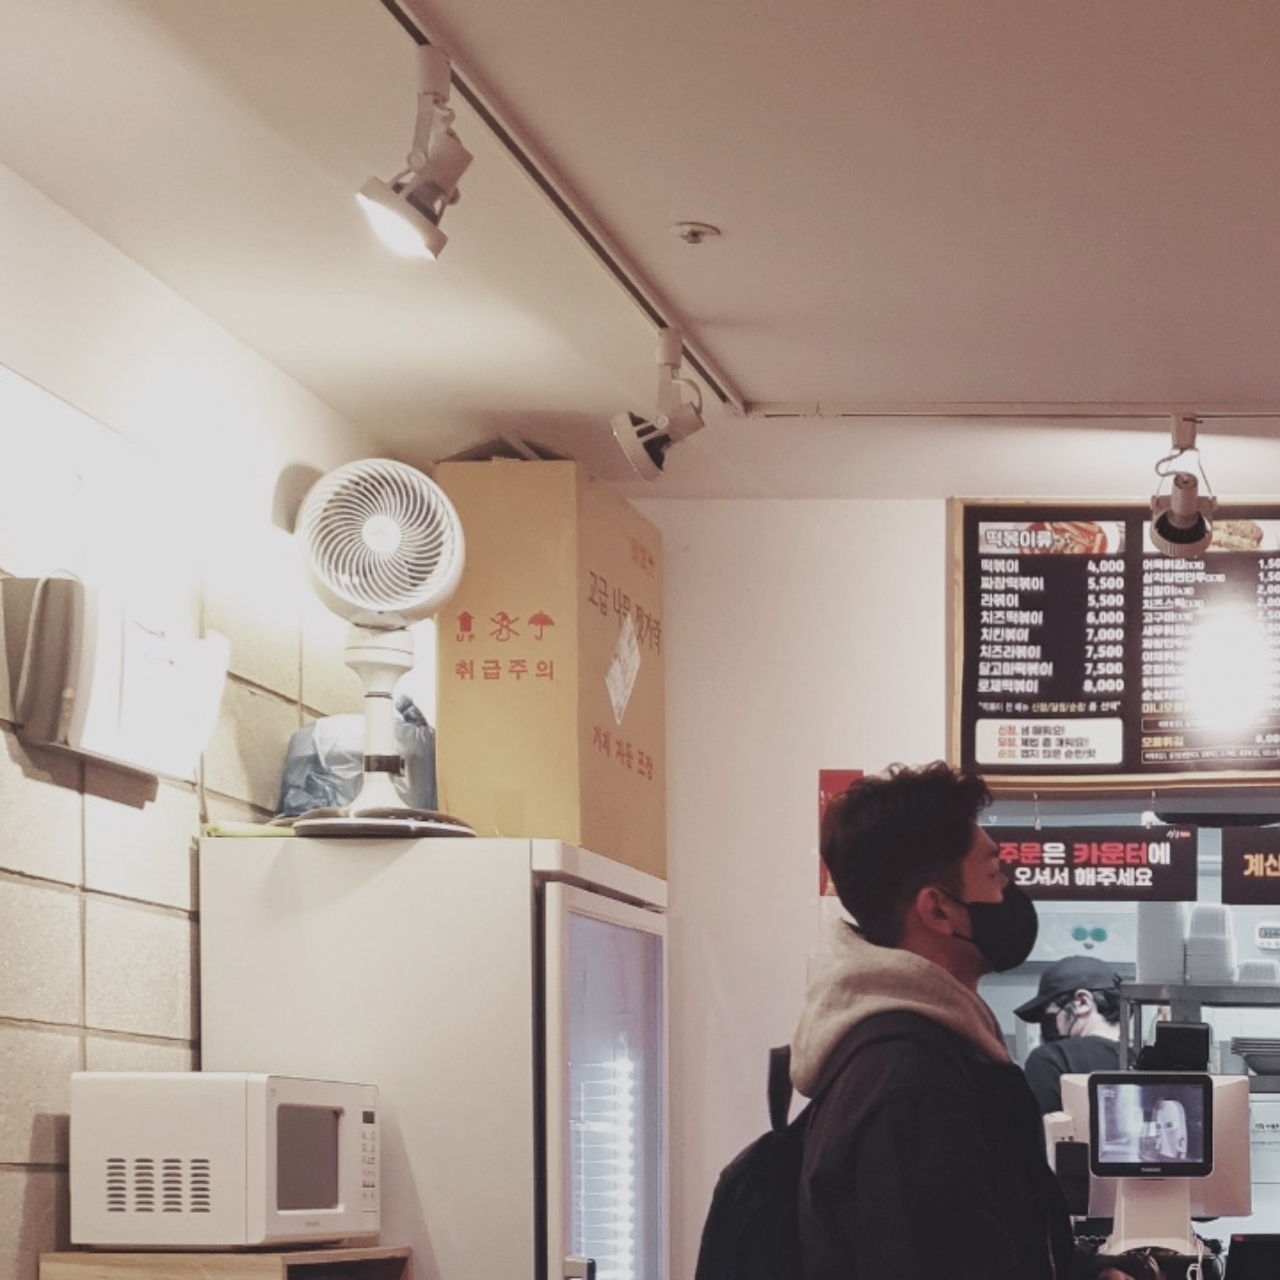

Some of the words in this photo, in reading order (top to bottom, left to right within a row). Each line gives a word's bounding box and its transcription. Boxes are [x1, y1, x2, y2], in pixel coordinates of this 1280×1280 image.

[985, 529, 1053, 548] 떡볶이류
[981, 559, 1019, 573] 떡볶이
[1087, 559, 1125, 574] 4,000
[980, 576, 1044, 591] 짜장떡볶이
[1087, 576, 1124, 591] 5,500
[980, 593, 1019, 608] 라볶이
[1087, 593, 1124, 608] 5,500
[980, 610, 1043, 625] 치즈떡볶이
[1086, 611, 1124, 625] 6,000
[1085, 628, 1124, 642] 7,000
[979, 645, 1042, 659] 치즈라볶이
[1085, 645, 1123, 659] 7,500
[455, 659, 554, 680] 취급주의
[1084, 662, 1123, 676] 7,500
[977, 679, 1039, 693] 로제떡볶이
[1083, 679, 1124, 693] 8,000
[999, 842, 1065, 864] 주문은
[1072, 842, 1171, 865] 카운터에
[1014, 867, 1069, 886] 오셔서
[1074, 867, 1153, 887] 해주세요
